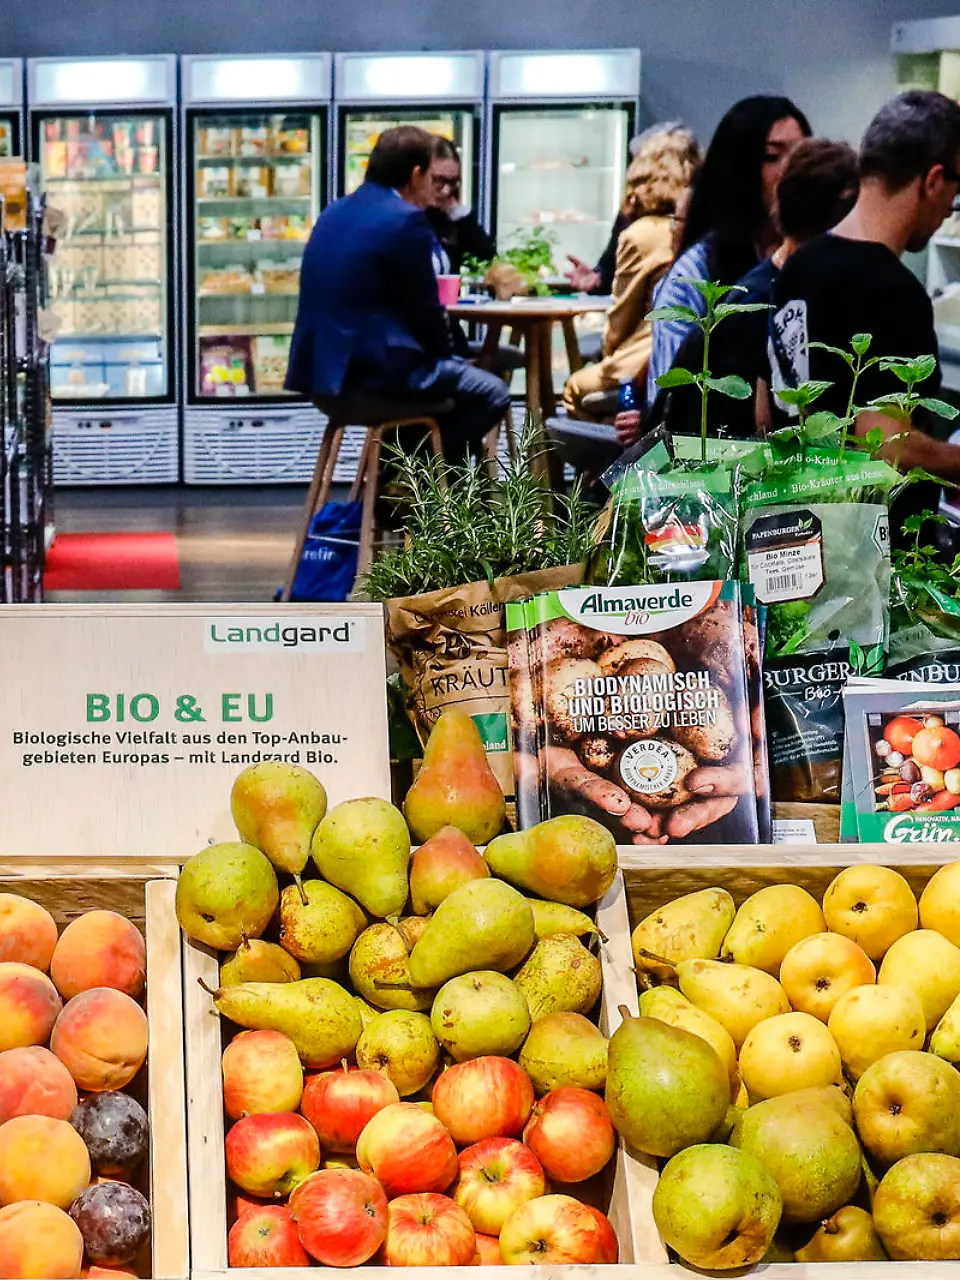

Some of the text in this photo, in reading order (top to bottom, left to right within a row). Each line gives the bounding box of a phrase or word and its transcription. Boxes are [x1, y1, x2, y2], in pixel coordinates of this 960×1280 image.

[747, 488, 778, 502] chland
[791, 476, 842, 493] Bio-Kräuter
[752, 525, 800, 540] PAPENBURGER
[766, 549, 801, 561] Bio Minze
[579, 589, 693, 614] Almaverde
[624, 609, 650, 626] bio
[210, 622, 351, 647] Landgard
[431, 665, 510, 697] KRÄUT
[575, 671, 710, 697] BIODYNAMISCH
[764, 661, 854, 688] BURGER
[86, 693, 274, 723] BIO & EU
[568, 689, 719, 717] UND BIOLOGISCH
[573, 710, 717, 733] UM BESSER ZU LEBEN
[13, 731, 348, 748] Biologische Vielfalt aus den Top-Anbau-
[485, 738, 506, 751] land
[22, 750, 97, 767] gebieten
[102, 751, 170, 767] Europas
[189, 750, 216, 764] mit
[221, 750, 300, 765] Landgard
[306, 751, 338, 764] Bio.
